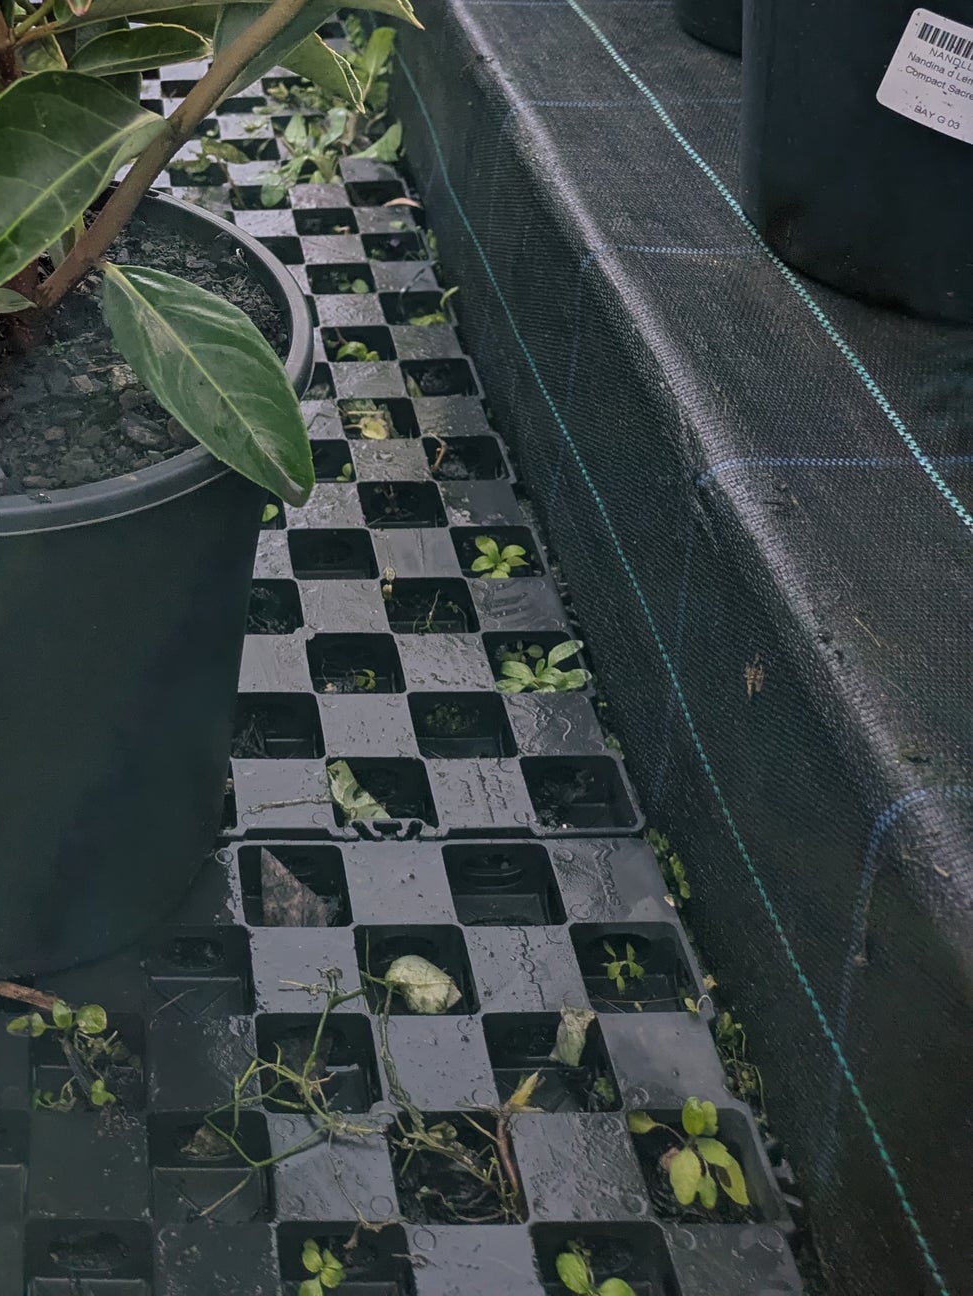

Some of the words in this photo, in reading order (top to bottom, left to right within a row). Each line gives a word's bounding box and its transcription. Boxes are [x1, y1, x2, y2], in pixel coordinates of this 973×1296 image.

[907, 51, 945, 74] Nandina
[905, 65, 946, 89] Compact
[914, 105, 935, 120] BAY
[947, 120, 961, 130] 03
